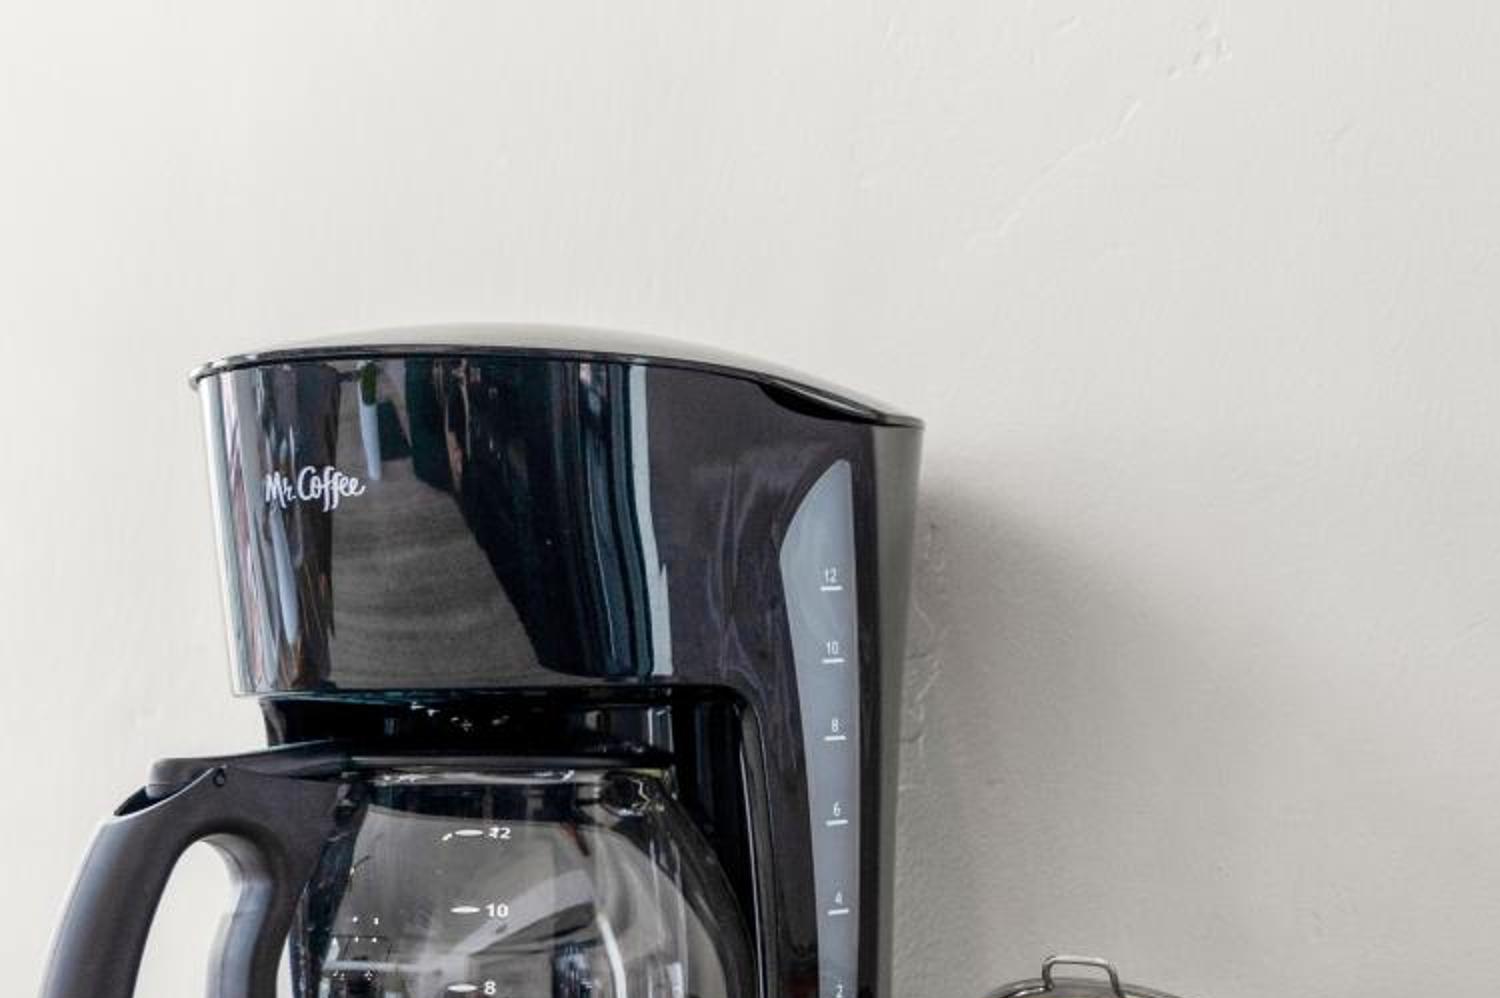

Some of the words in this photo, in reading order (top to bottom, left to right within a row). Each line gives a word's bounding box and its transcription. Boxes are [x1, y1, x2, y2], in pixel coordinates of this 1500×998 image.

[266, 471, 296, 509] Mr.
[298, 466, 366, 512] Coffee
[824, 568, 837, 583] 12
[826, 641, 839, 655] 10
[831, 718, 839, 732] 8
[833, 802, 841, 817] 6
[835, 891, 843, 905] 4
[485, 903, 509, 917] 10
[483, 981, 496, 995] 8
[835, 984, 843, 998] 2
